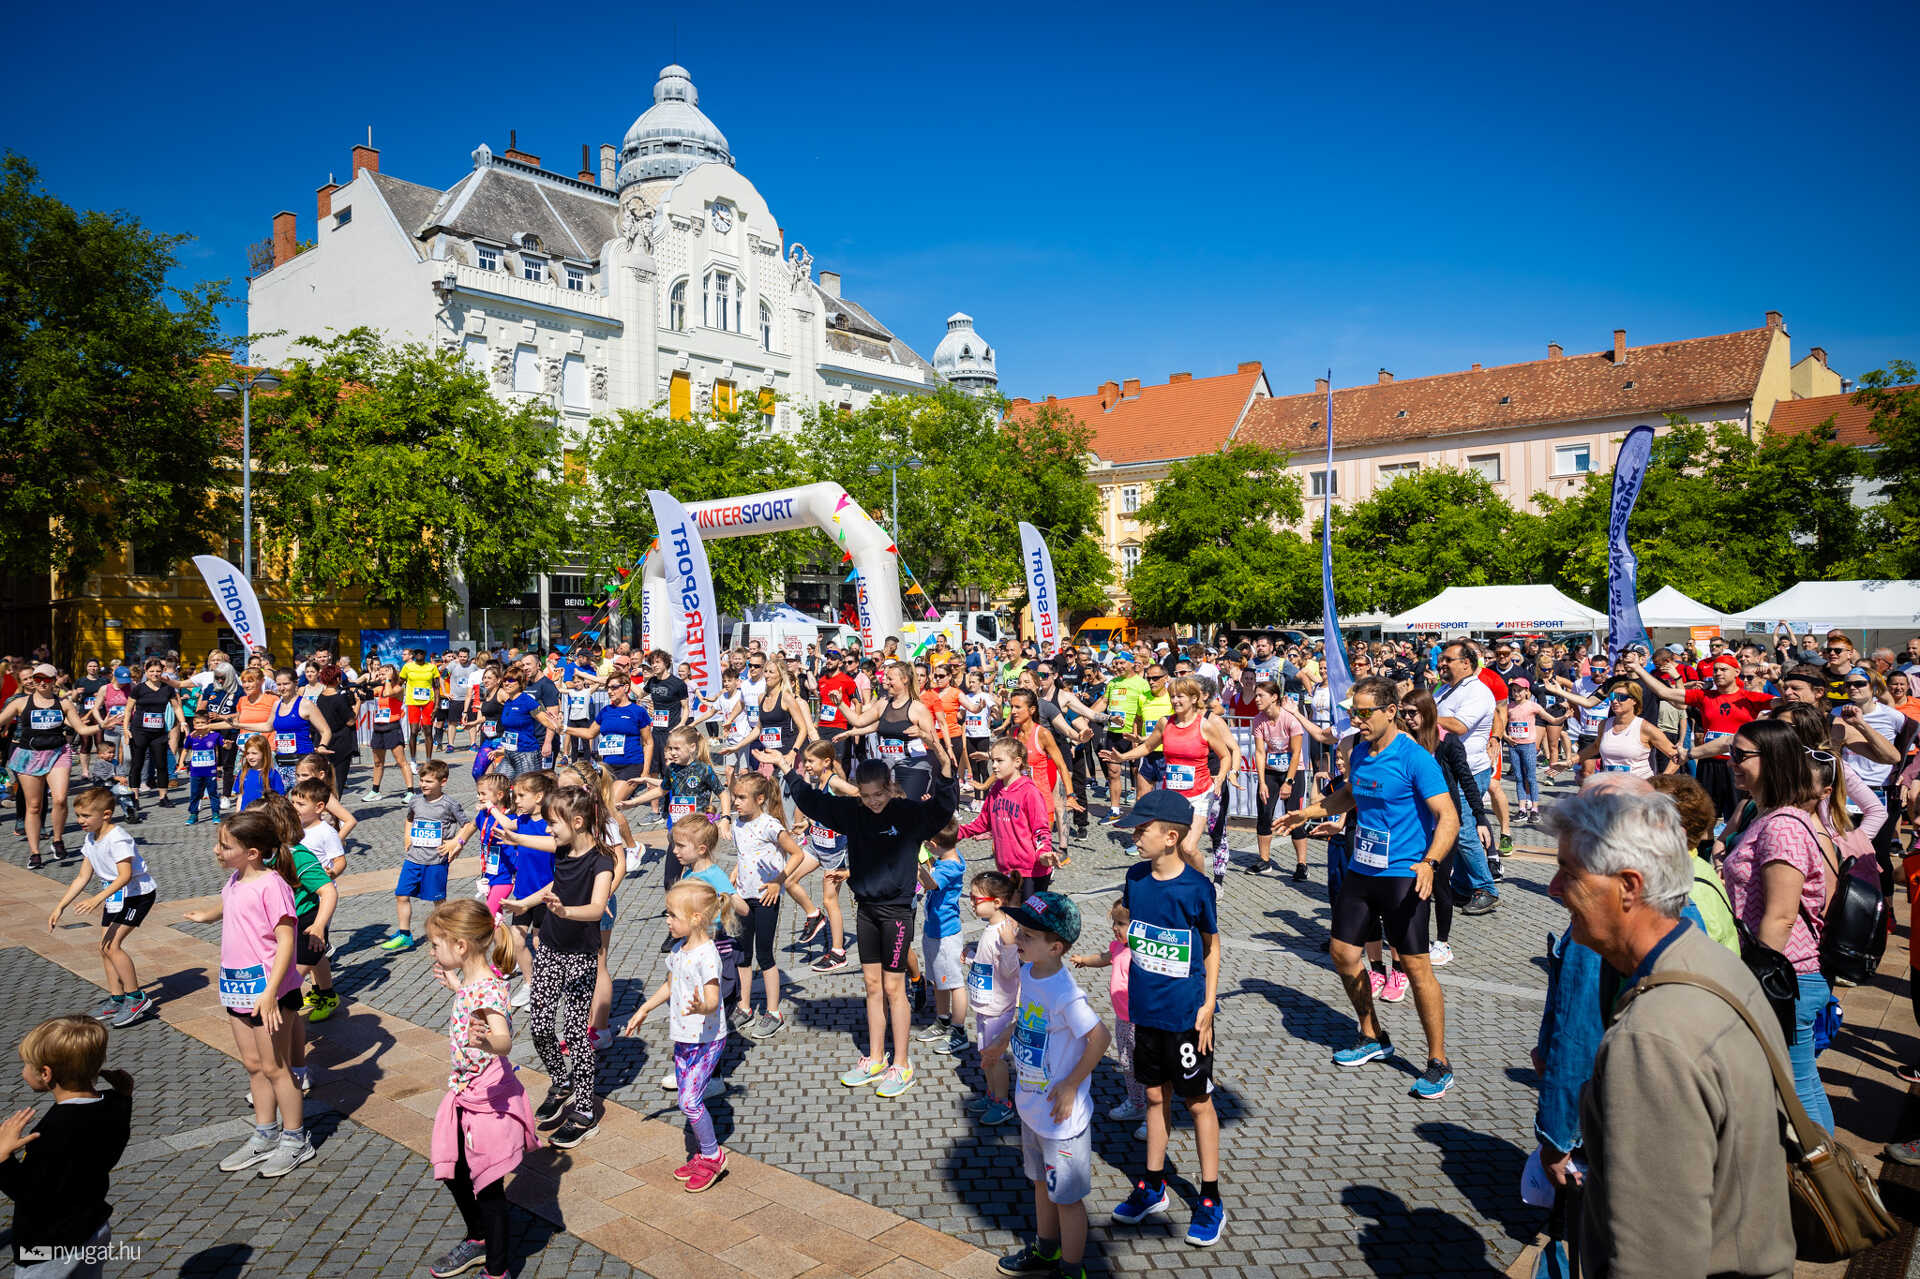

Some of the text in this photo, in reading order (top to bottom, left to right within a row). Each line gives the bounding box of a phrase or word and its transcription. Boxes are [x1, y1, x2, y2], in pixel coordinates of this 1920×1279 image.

[699, 498, 794, 529] INTERSPORT
[564, 598, 585, 606] BENU
[642, 589, 651, 651] ERSPORT
[1504, 620, 1564, 628] INTERSPORT
[414, 829, 436, 838] 1056
[1360, 840, 1374, 852] 57
[125, 907, 137, 921] 10
[1135, 939, 1180, 961] 2042
[223, 981, 257, 993] 1217
[1179, 1042, 1197, 1069] 8
